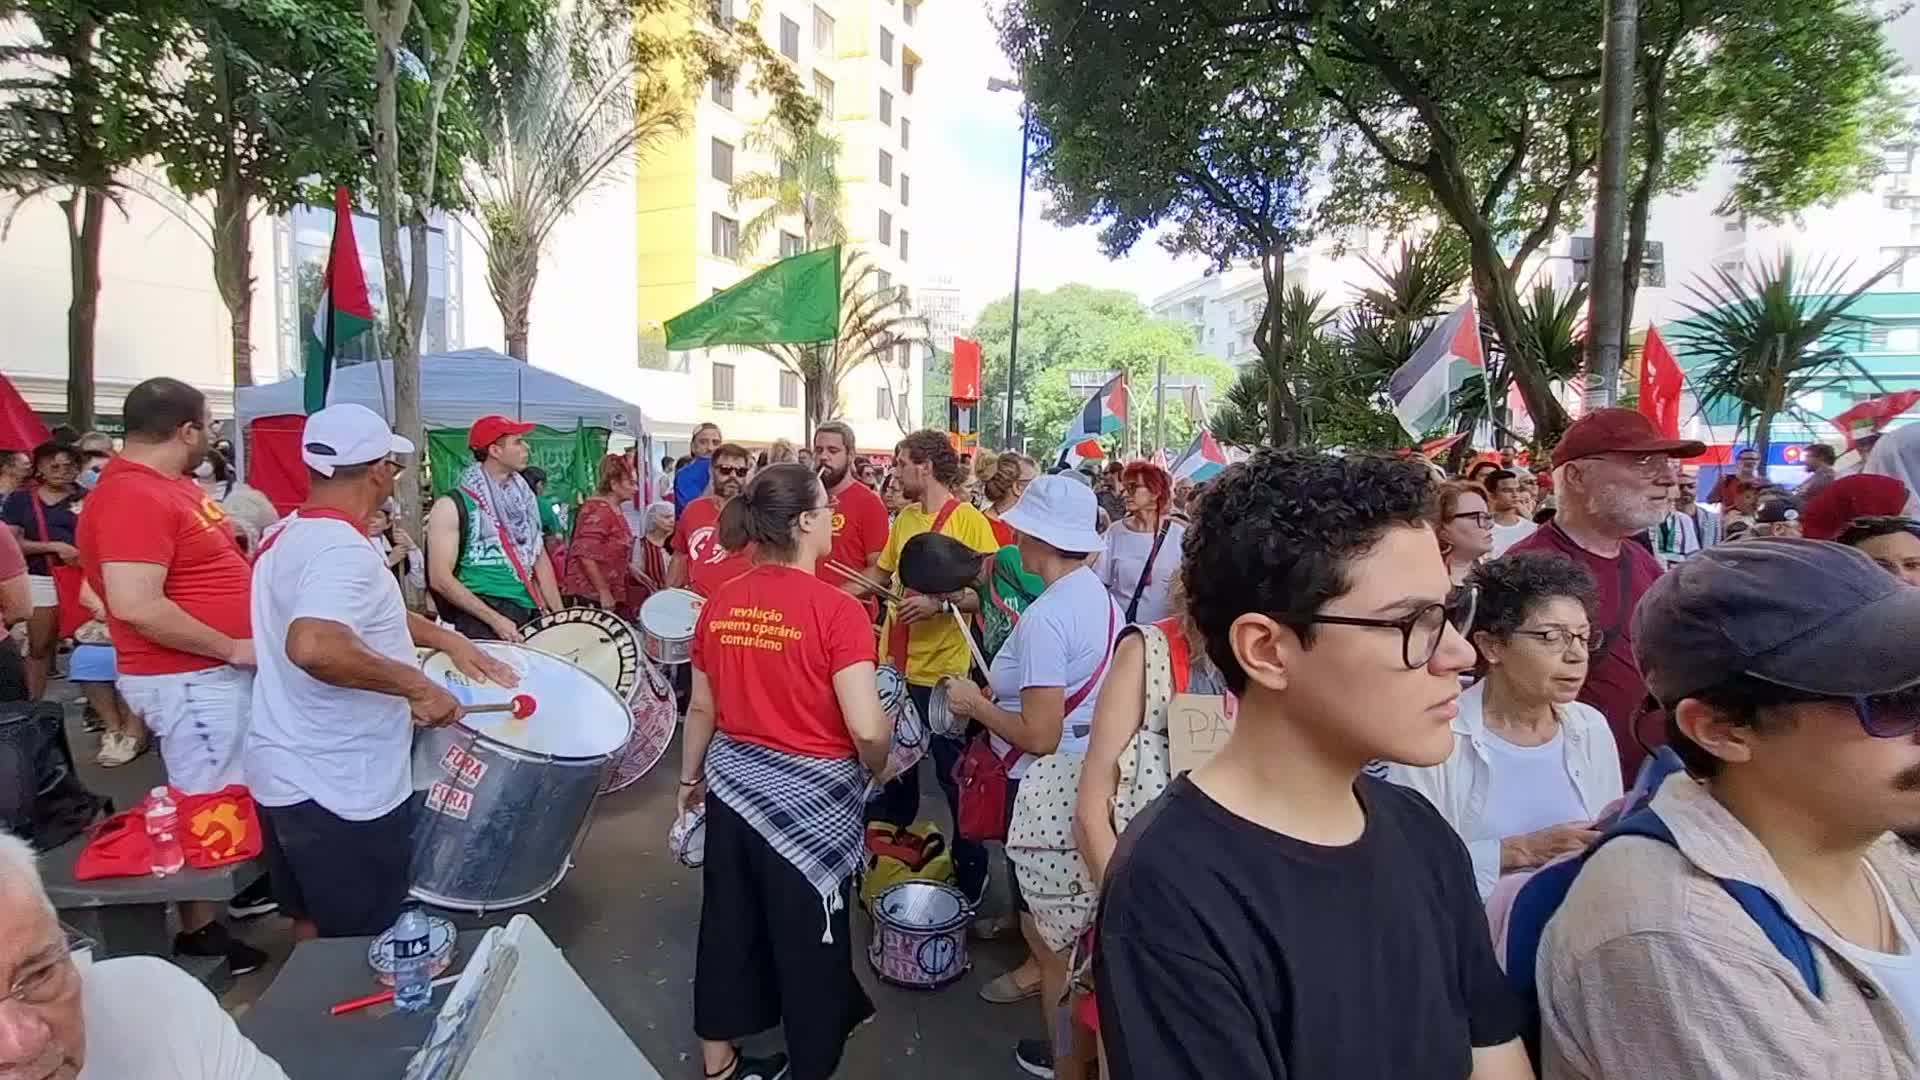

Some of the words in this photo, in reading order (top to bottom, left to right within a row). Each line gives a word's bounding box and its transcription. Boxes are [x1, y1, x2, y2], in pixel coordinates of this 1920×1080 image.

[709, 620, 751, 632] governo
[752, 623, 802, 640] operário
[720, 634, 783, 651] comunismo
[446, 745, 482, 779] FORA
[432, 783, 468, 810] FORA
